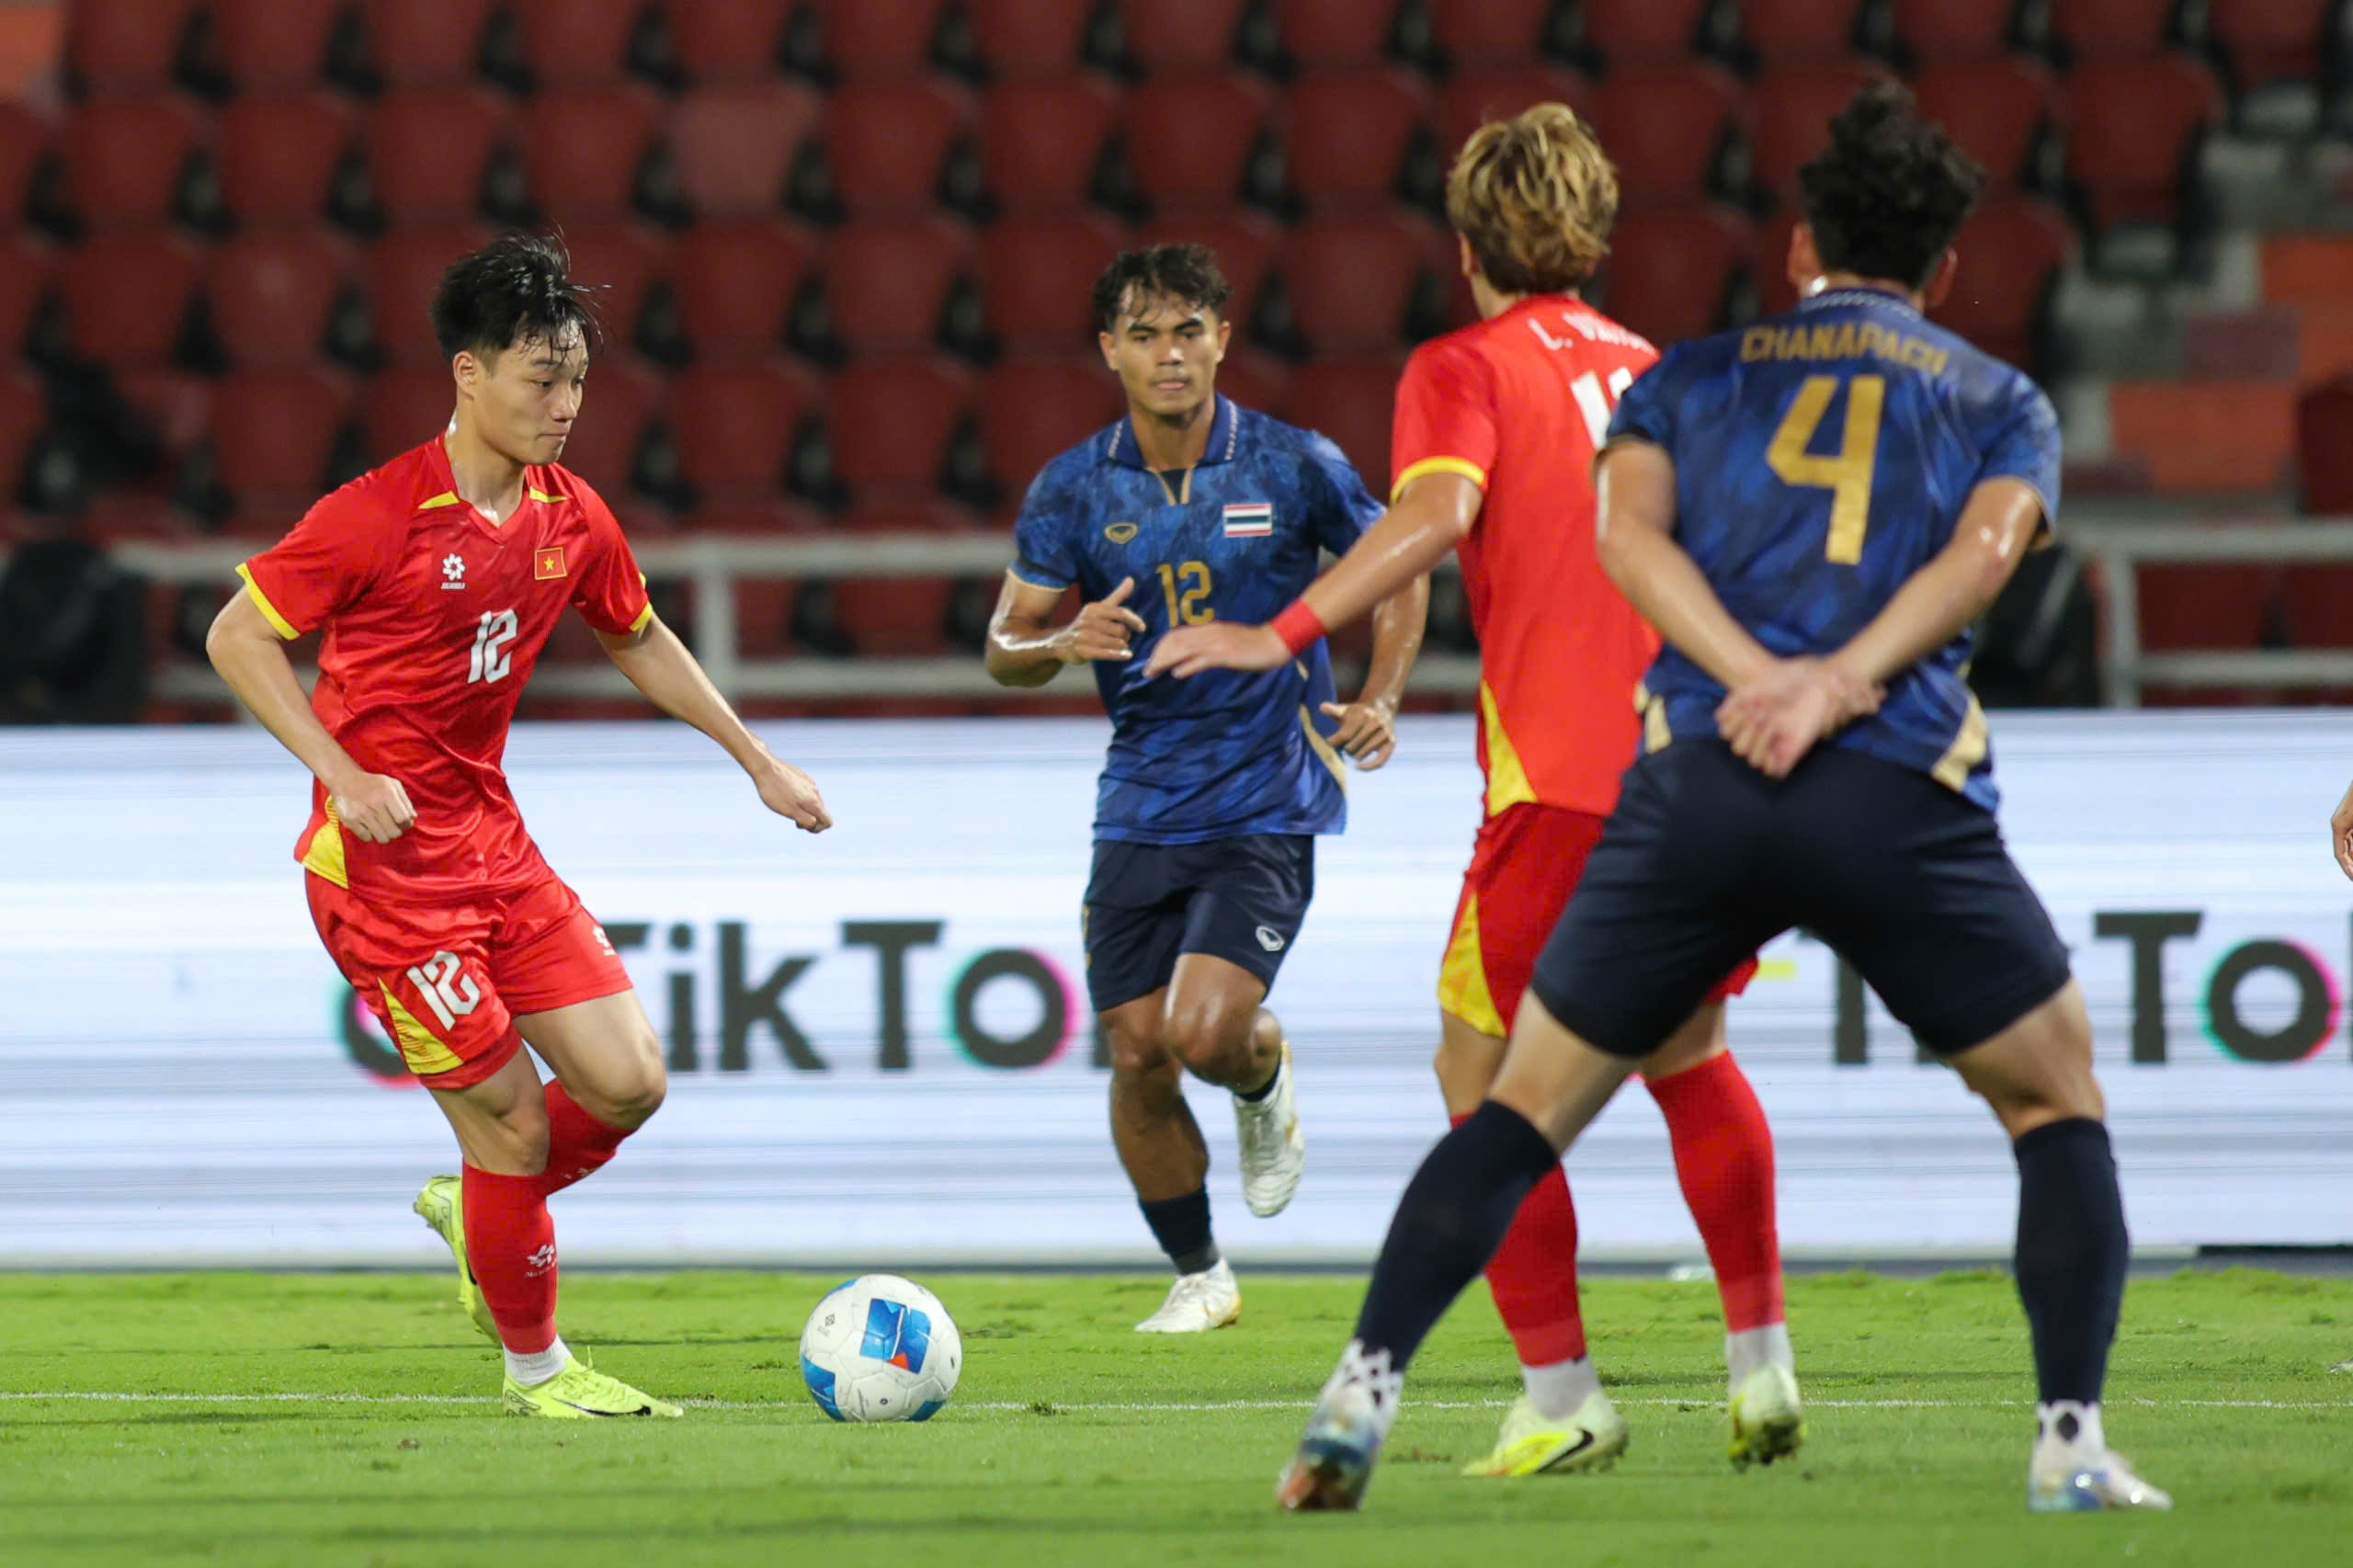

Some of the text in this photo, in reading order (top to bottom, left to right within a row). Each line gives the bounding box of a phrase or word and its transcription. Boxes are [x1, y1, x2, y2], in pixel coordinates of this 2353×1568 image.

[1767, 375, 1886, 566] 4
[1155, 561, 1214, 630] 12
[467, 608, 518, 684] 12
[405, 950, 481, 1032] 12
[602, 919, 1110, 1070] ikTo
